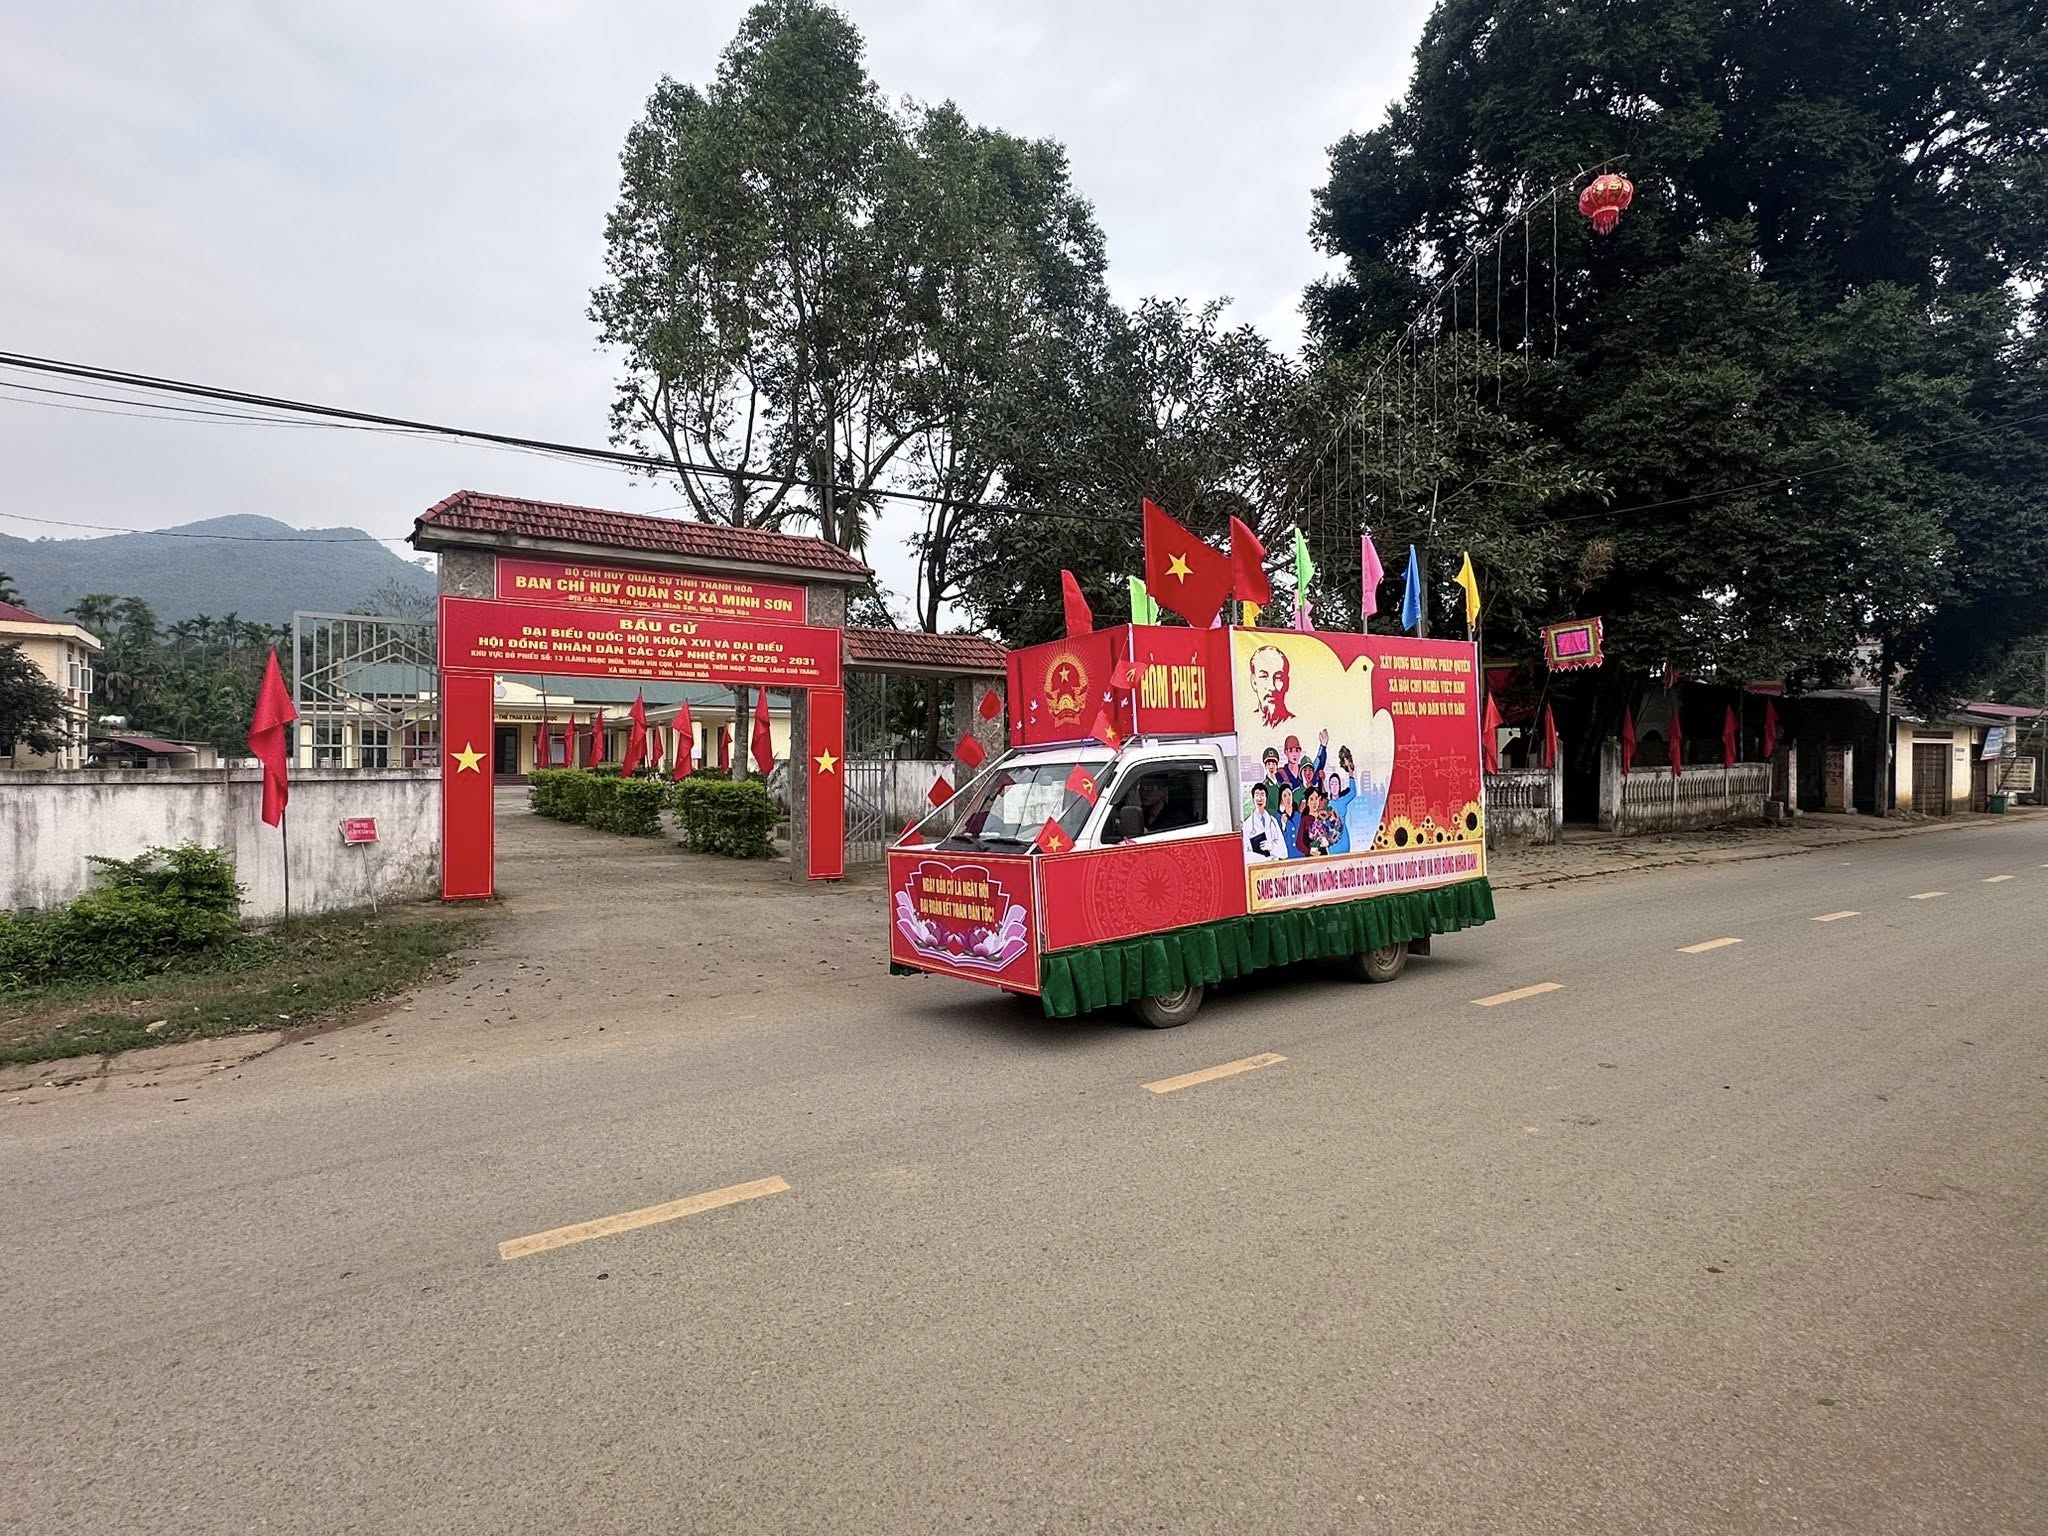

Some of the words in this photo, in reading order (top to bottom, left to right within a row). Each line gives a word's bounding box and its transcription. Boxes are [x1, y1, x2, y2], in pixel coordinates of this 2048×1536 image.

[565, 568, 580, 576] BỘ
[583, 568, 600, 578] CHỈ
[604, 572, 624, 580] HUY
[628, 573, 656, 584] QUÂN
[659, 576, 672, 586] SỰ
[675, 577, 698, 588] TỈNH
[700, 581, 732, 592] THANH
[734, 584, 753, 594] HÓA
[516, 576, 552, 590] BAN
[557, 578, 585, 592] CHỈ
[590, 582, 621, 595] HUY
[626, 584, 668, 599] QUÂN
[674, 590, 695, 604] SỰ
[698, 591, 718, 604] XÃ
[722, 594, 760, 608] MINH
[764, 598, 792, 612] SƠN
[620, 618, 662, 632] BẦU
[668, 622, 698, 634] CỬ
[478, 636, 504, 648] HỘI
[508, 637, 548, 650] ĐỒNG
[552, 642, 592, 654] NHÂN
[596, 644, 624, 655] DÂN
[628, 645, 654, 656] CÁC
[658, 646, 684, 658] CẤP
[687, 650, 728, 662] NHIỆM
[731, 652, 747, 663] KỲ
[750, 654, 778, 664] 2026
[789, 657, 815, 666] 2031
[522, 626, 546, 638] ĐẠI
[550, 627, 583, 639] BIỂU
[588, 630, 624, 642] QUỐC
[627, 632, 648, 644] HỘI
[653, 635, 688, 646] KHÓA
[691, 639, 711, 648] XVI
[714, 638, 730, 649] VÀ
[734, 642, 753, 652] ĐẠI
[756, 641, 784, 652] BIỂU
[488, 650, 503, 658] VỰC
[517, 651, 538, 660] PHIẾU
[1380, 652, 1393, 669] XÂY
[1393, 656, 1410, 672] DỰNG
[1422, 656, 1438, 672] NƯỚC
[1141, 652, 1168, 709] HÒM
[1171, 652, 1206, 709] PHIẾU
[1388, 676, 1398, 692] XÃ
[1398, 676, 1410, 695] HỘI
[1410, 676, 1422, 692] CHỦ
[1422, 677, 1440, 693] NGHĨA
[1453, 680, 1466, 694] NAM
[1418, 702, 1428, 716] DO
[922, 875, 936, 892] NGÀY
[962, 879, 978, 898] NGÀY
[1274, 870, 1289, 898] SUỐT
